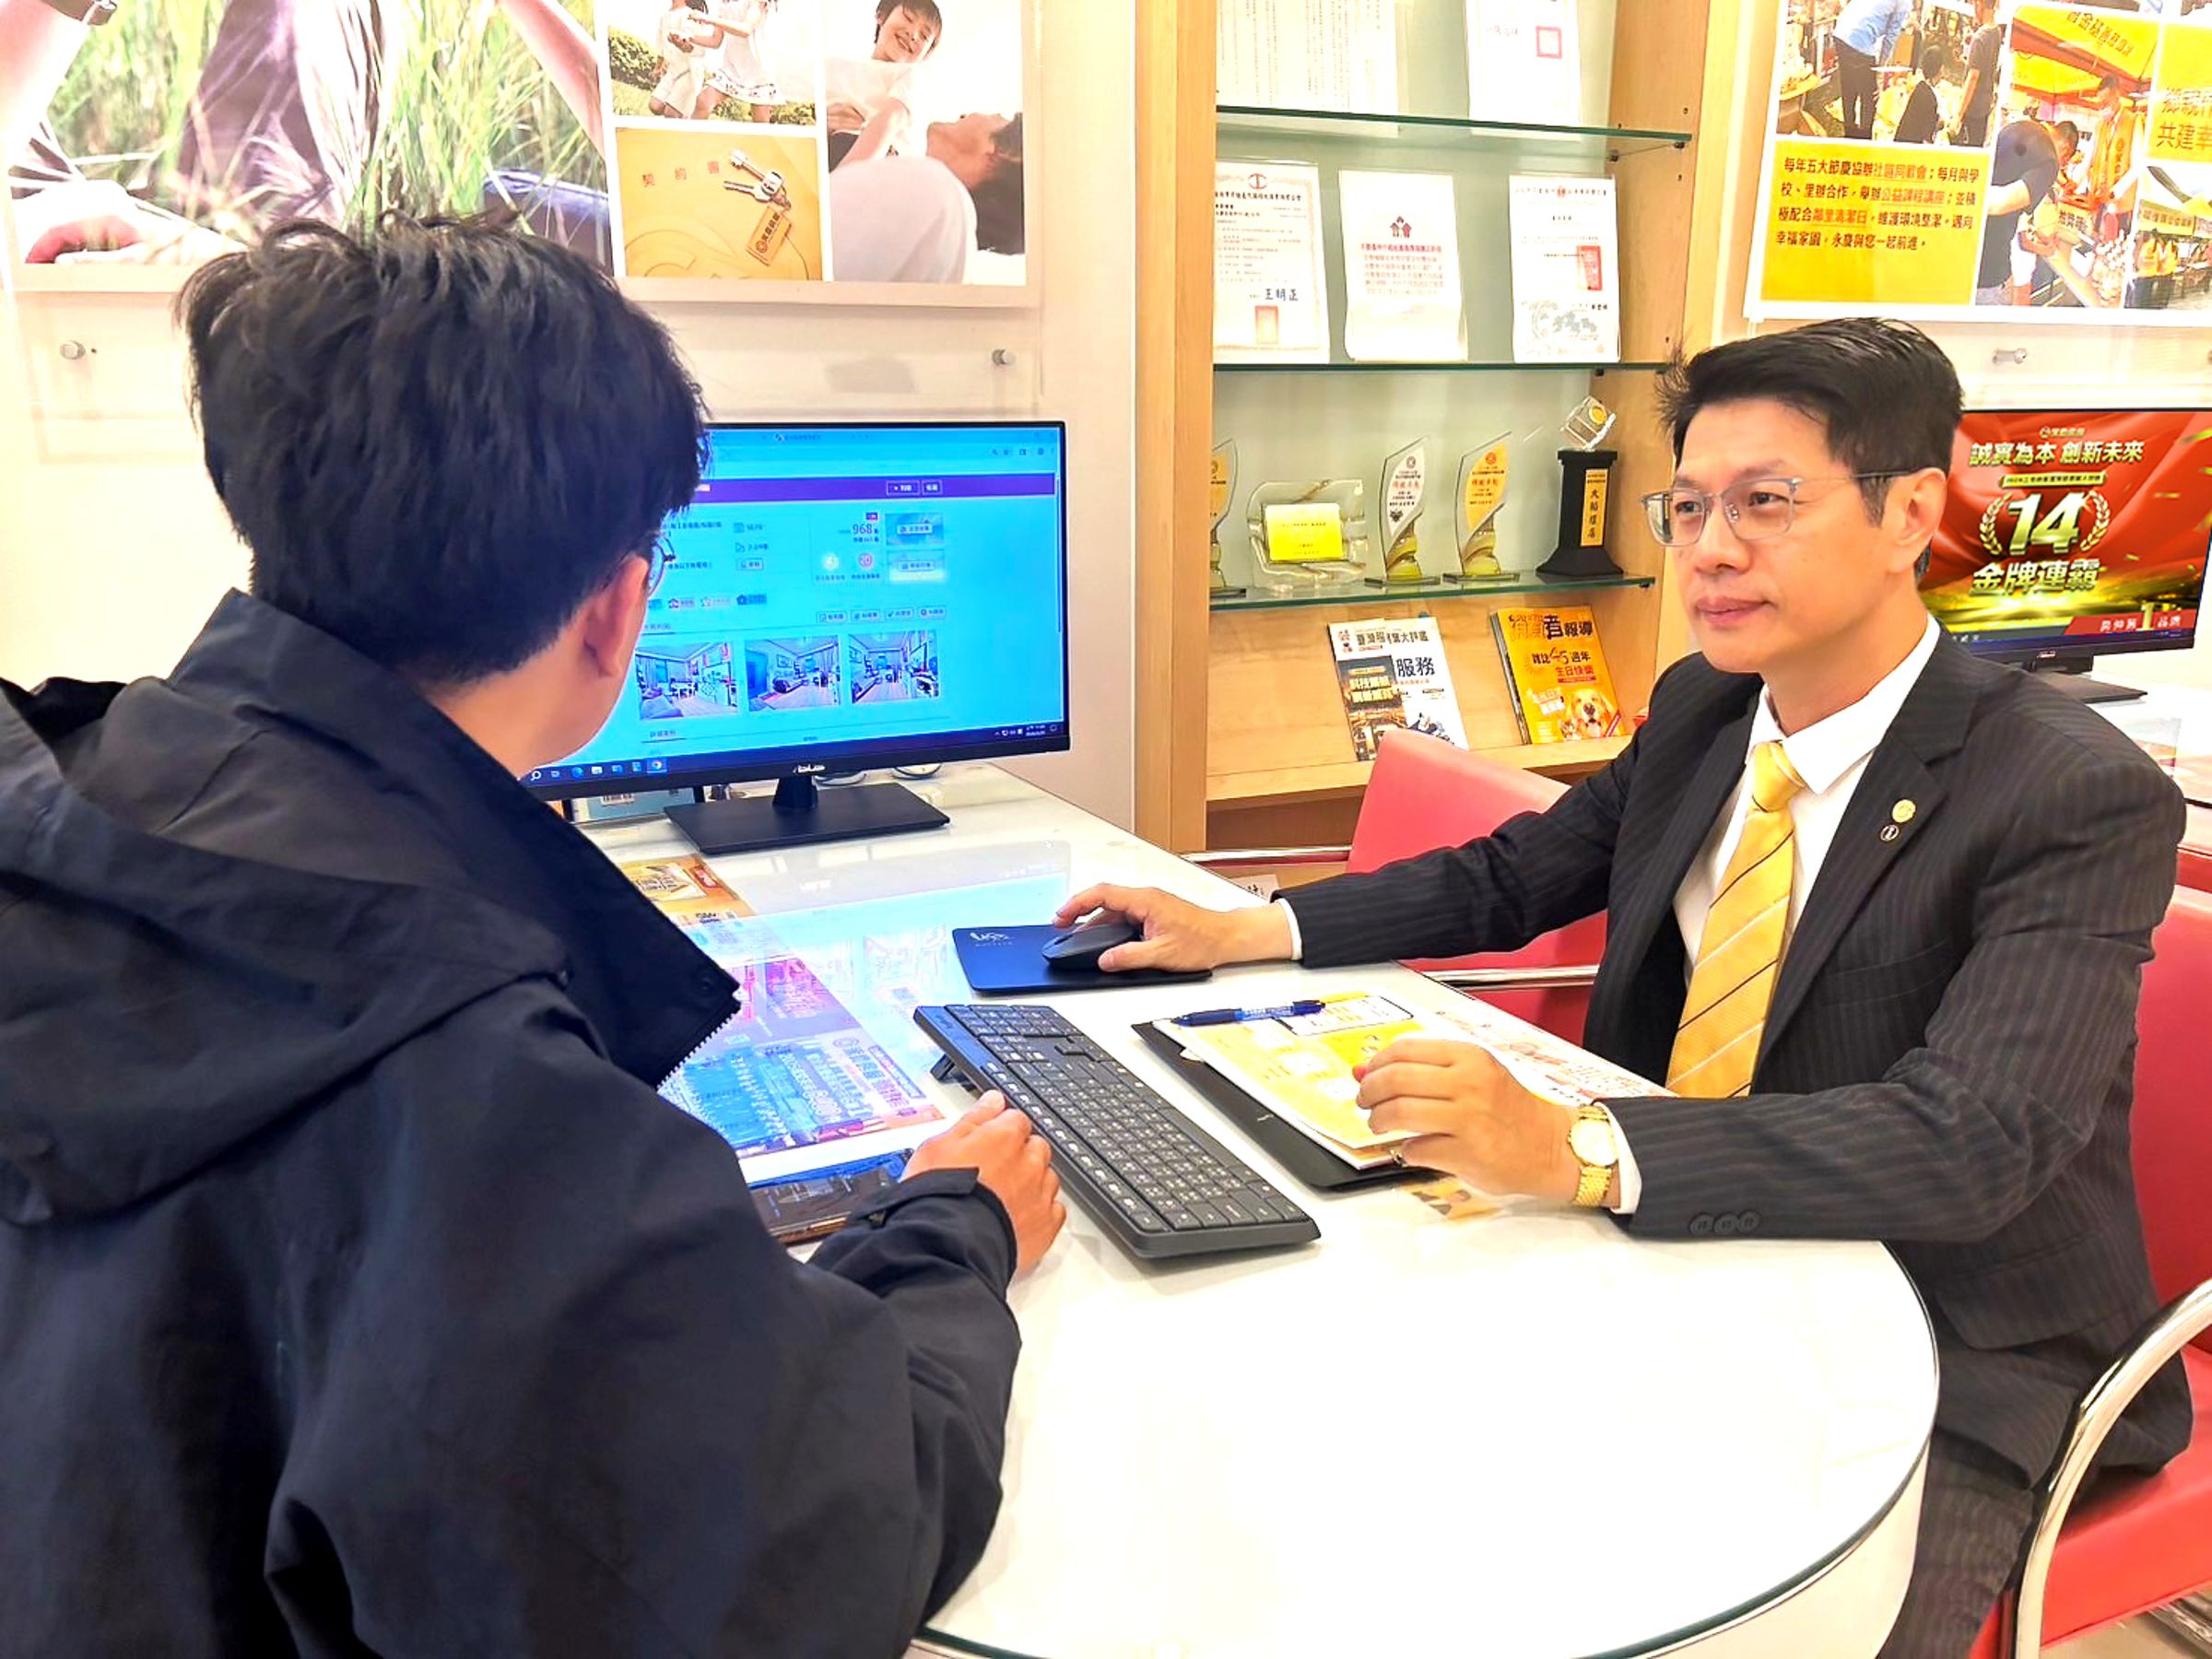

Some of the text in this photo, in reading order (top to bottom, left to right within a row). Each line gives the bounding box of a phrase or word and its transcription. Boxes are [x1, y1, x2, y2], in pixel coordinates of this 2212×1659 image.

[1969, 441, 2146, 465] 誠實為本 創新未來
[2006, 492, 2087, 556] 14
[1969, 559, 2101, 597] 金牌連霸
[1508, 614, 1594, 642] 消費者報導
[1395, 655, 1437, 679] 服務
